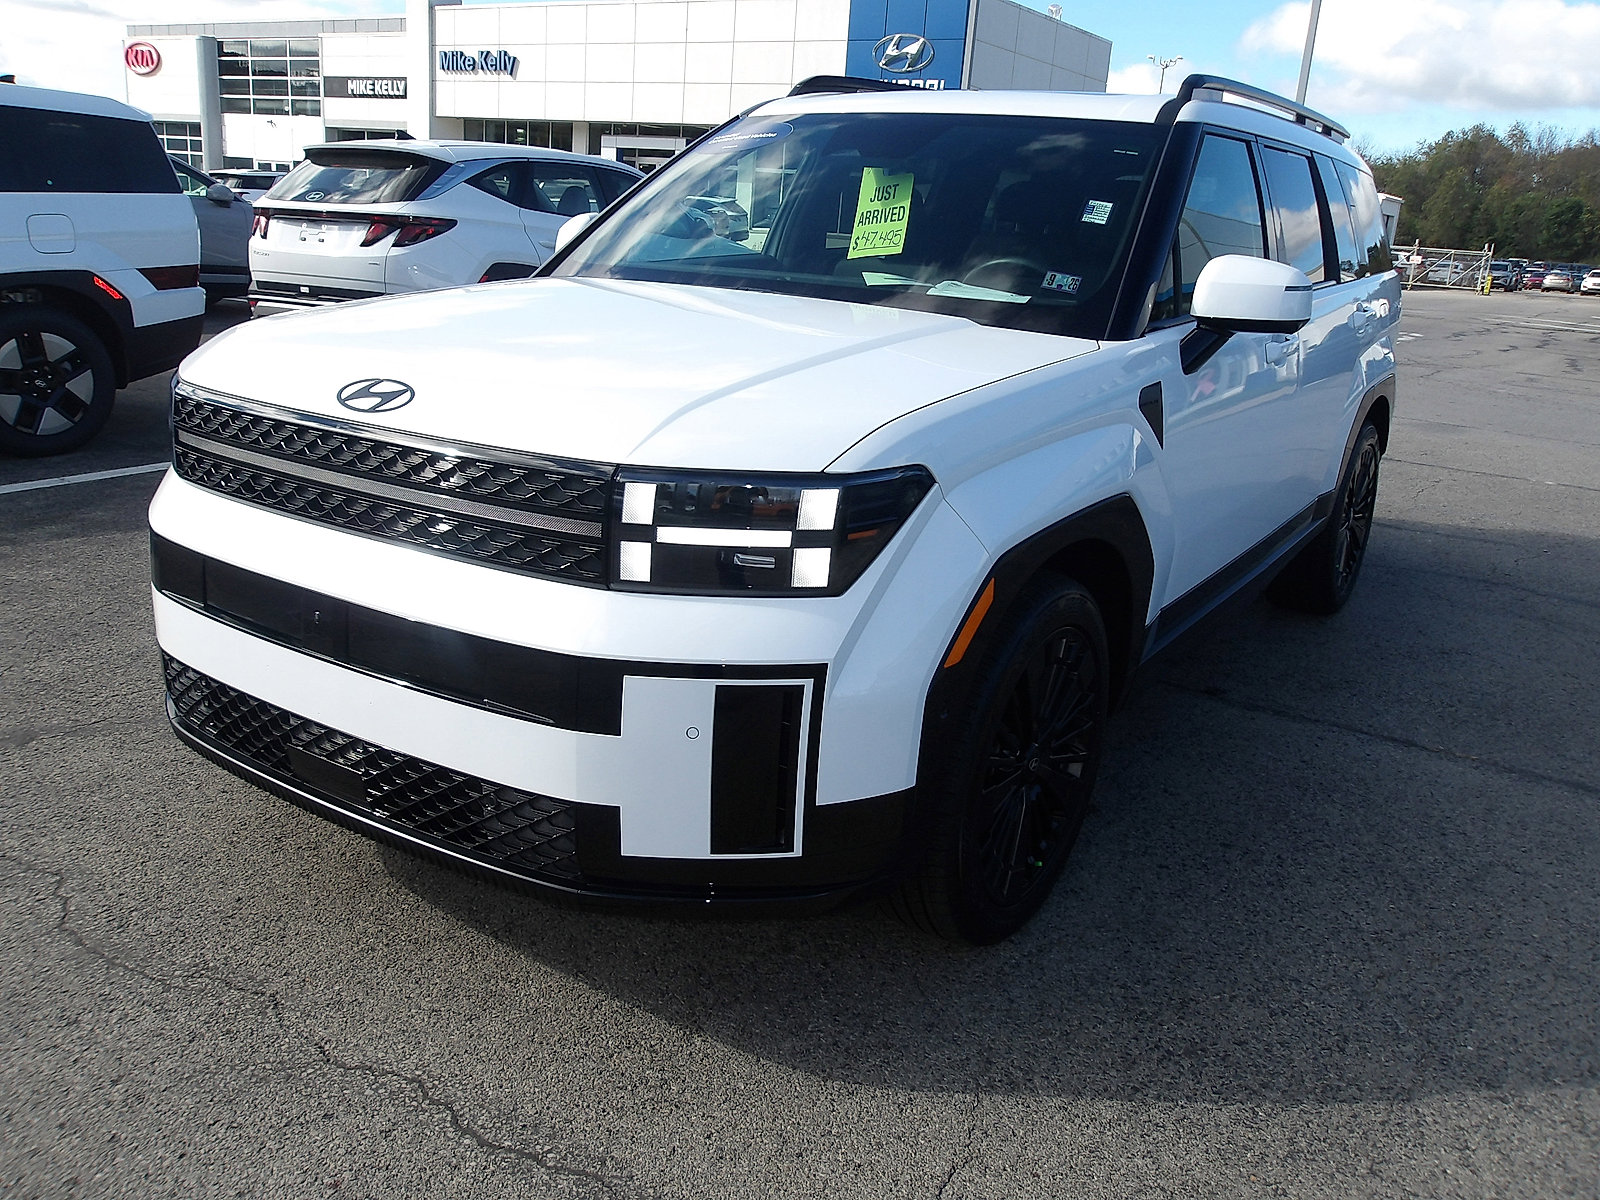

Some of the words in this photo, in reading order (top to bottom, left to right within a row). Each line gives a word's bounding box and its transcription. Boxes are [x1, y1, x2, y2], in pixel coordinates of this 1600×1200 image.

[128, 48, 155, 67] KIA
[439, 50, 475, 71] Mike
[478, 50, 517, 76] Kelly
[347, 79, 374, 95] MIKE
[375, 79, 406, 96] KELLY
[870, 183, 899, 203] JUST
[856, 205, 905, 227] ARRIVED
[1047, 273, 1057, 287] 9
[1067, 277, 1079, 291] 26
